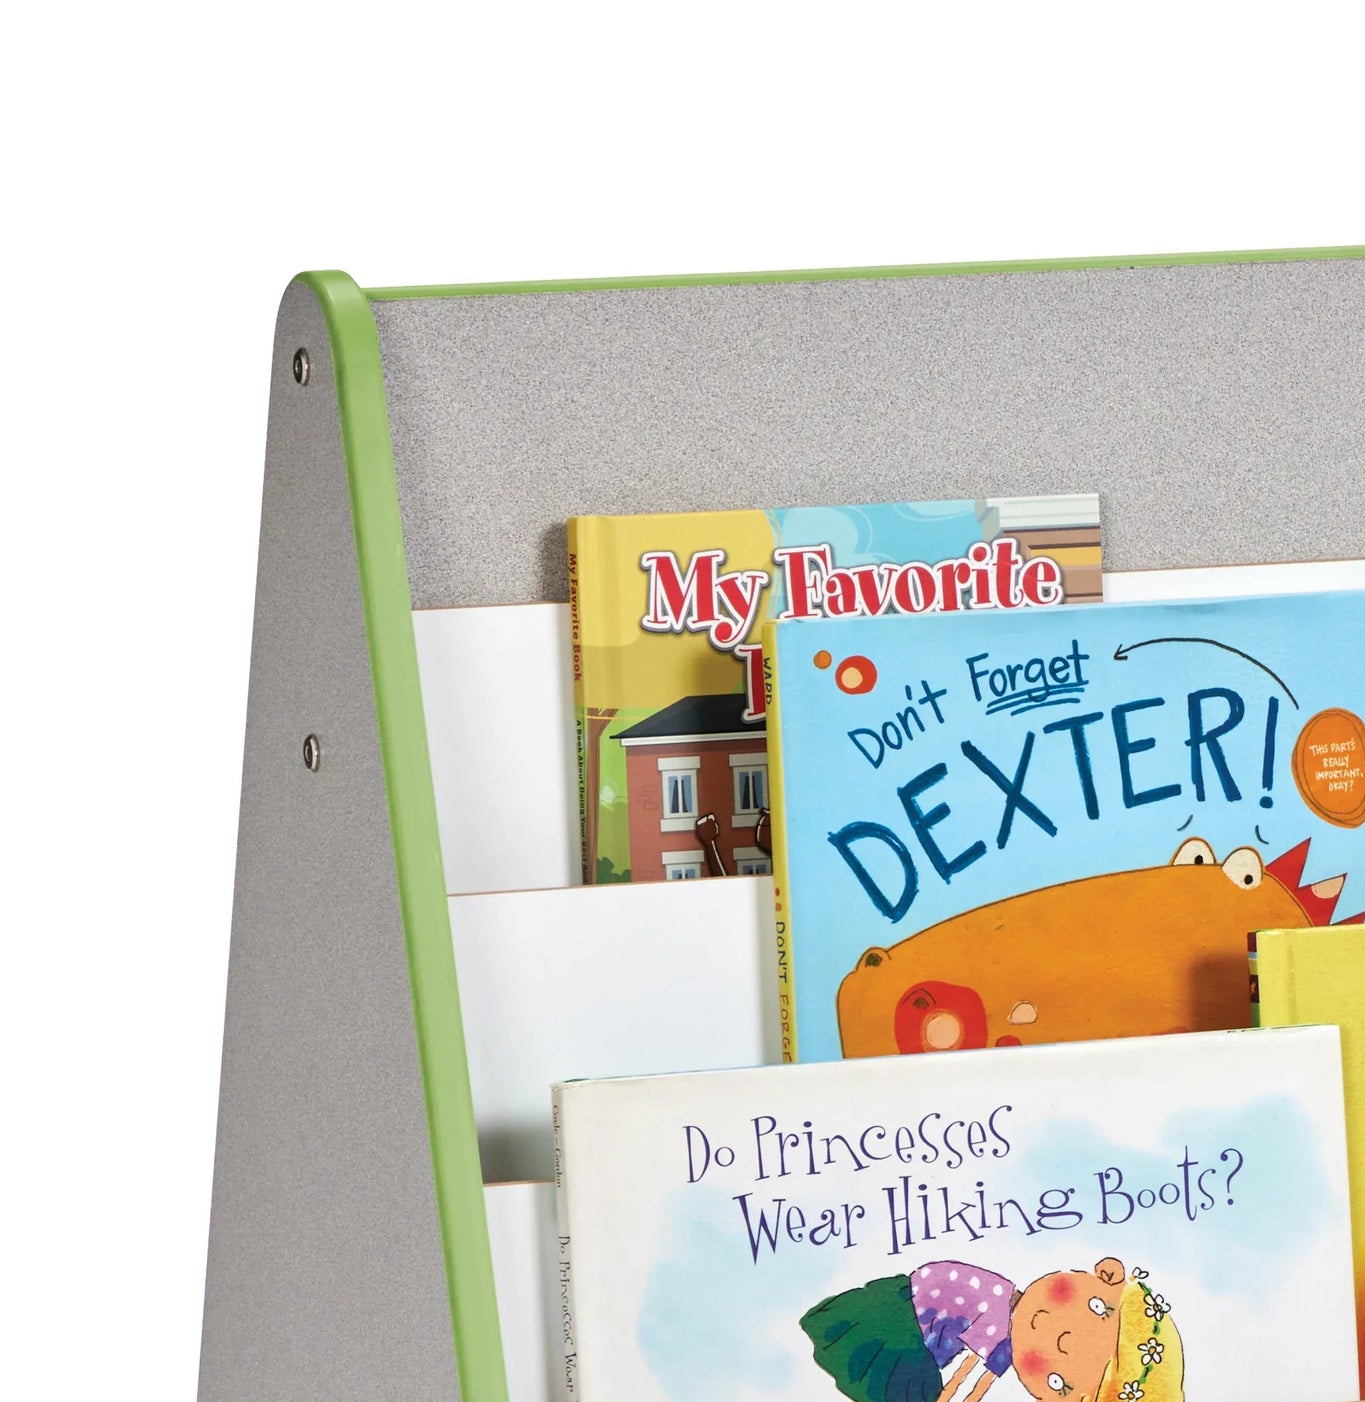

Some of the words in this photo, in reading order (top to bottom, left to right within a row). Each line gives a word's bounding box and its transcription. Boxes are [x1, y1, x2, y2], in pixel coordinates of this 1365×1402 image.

[569, 553, 577, 574] My
[641, 549, 768, 648] My
[774, 537, 1062, 619] Favorite
[570, 577, 580, 642] Favorite
[573, 645, 582, 682] Book
[847, 680, 948, 770] Don't
[966, 639, 1091, 704] Forget
[1309, 744, 1328, 756] THIS
[1331, 738, 1355, 752] PART'S
[1323, 755, 1349, 768] REALLY
[828, 687, 1280, 923] DEXTER!
[1328, 780, 1354, 791] OKAY?
[776, 921, 787, 983] DON'T
[682, 1124, 736, 1184] Do
[750, 1104, 1014, 1183] Princesses
[732, 1192, 867, 1267] Wear
[882, 1175, 1084, 1257] Hiking
[1096, 1147, 1245, 1225] Boots?
[558, 1236, 570, 1254] Do
